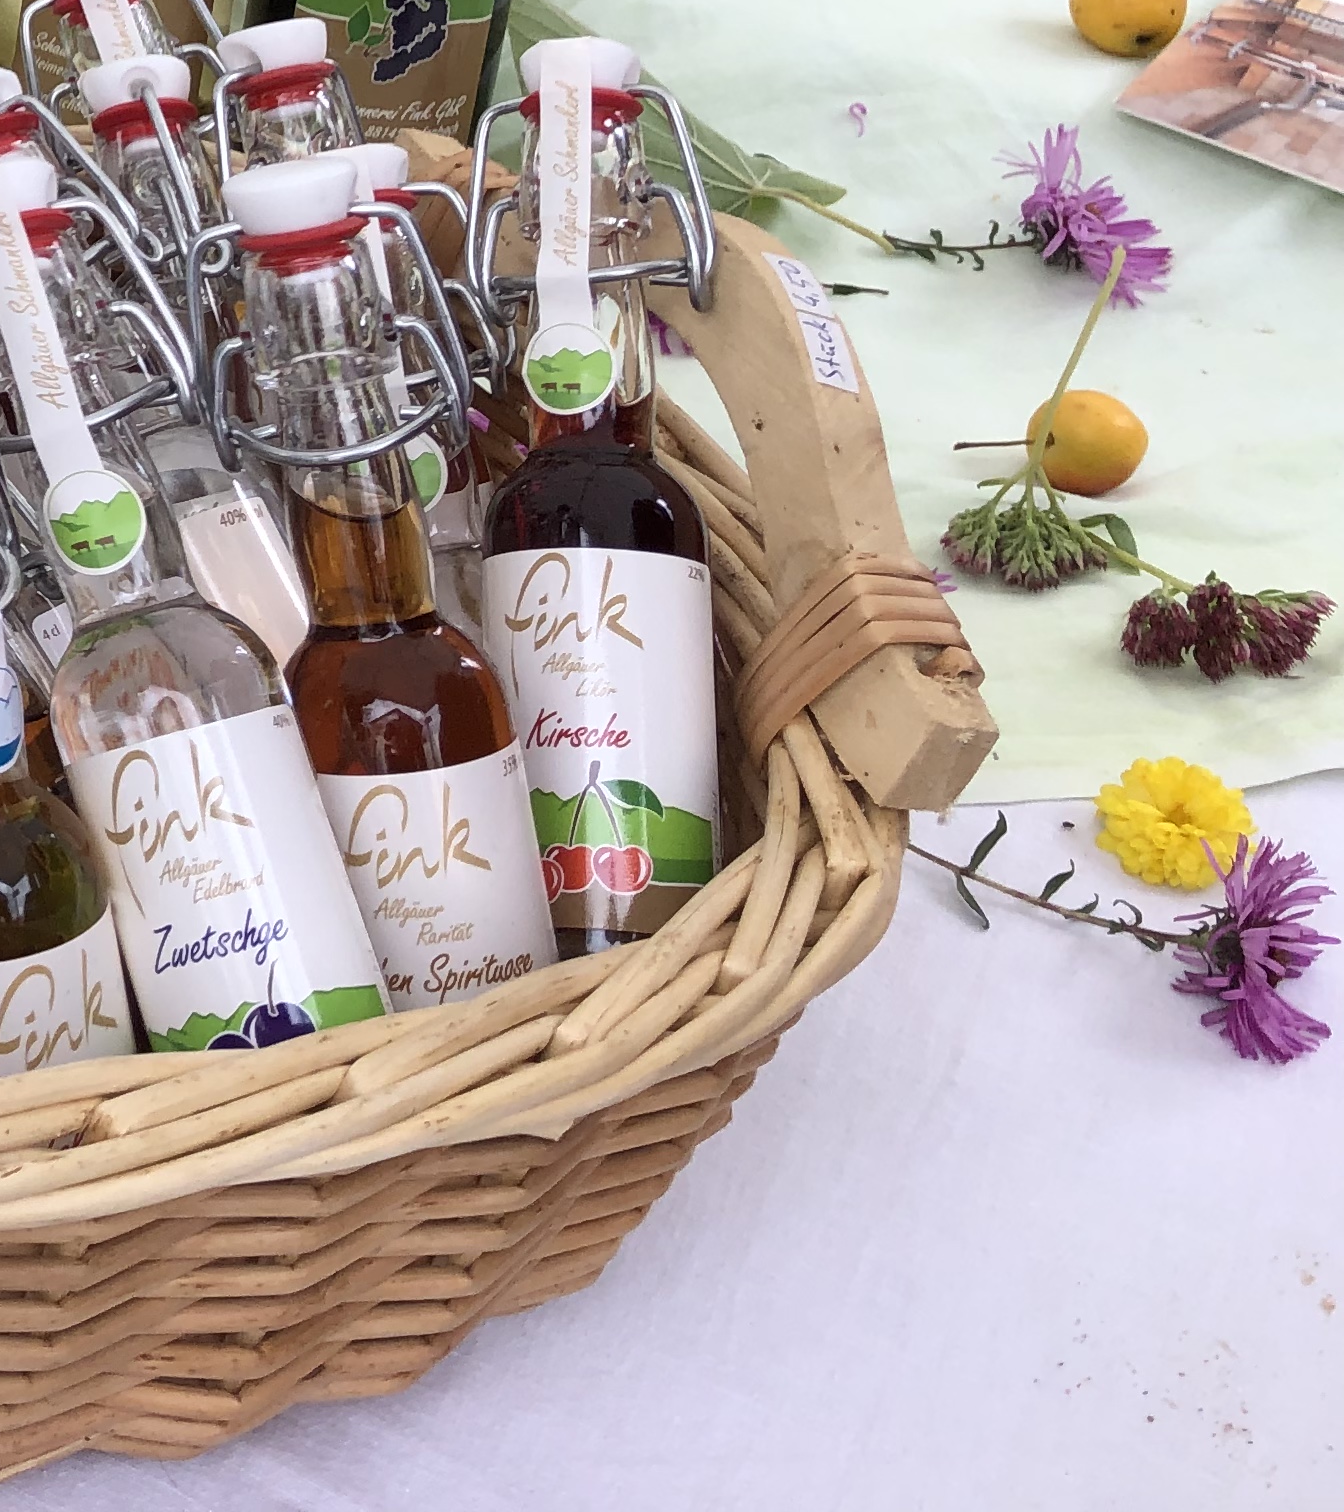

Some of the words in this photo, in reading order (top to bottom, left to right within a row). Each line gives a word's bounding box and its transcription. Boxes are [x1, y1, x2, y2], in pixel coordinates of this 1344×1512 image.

[401, 100, 436, 122] Fink
[435, 94, 468, 125] GbR
[559, 80, 582, 195] Schmankerl
[29, 322, 70, 411] Allgäuer
[220, 508, 247, 527] 40%
[42, 627, 50, 642] 4
[504, 552, 644, 698] fink
[541, 651, 606, 676] Allgäuer
[575, 675, 618, 699] Likör
[526, 707, 632, 751] Kirsche
[105, 737, 255, 918] fink
[343, 783, 493, 890] fink
[159, 856, 223, 887] Allgäuer
[192, 865, 266, 904] Edelbrand
[374, 896, 445, 922] Allgäuer
[153, 907, 289, 975] Zwetschge
[416, 922, 475, 946] Rarität
[423, 951, 535, 1005] Spirituose
